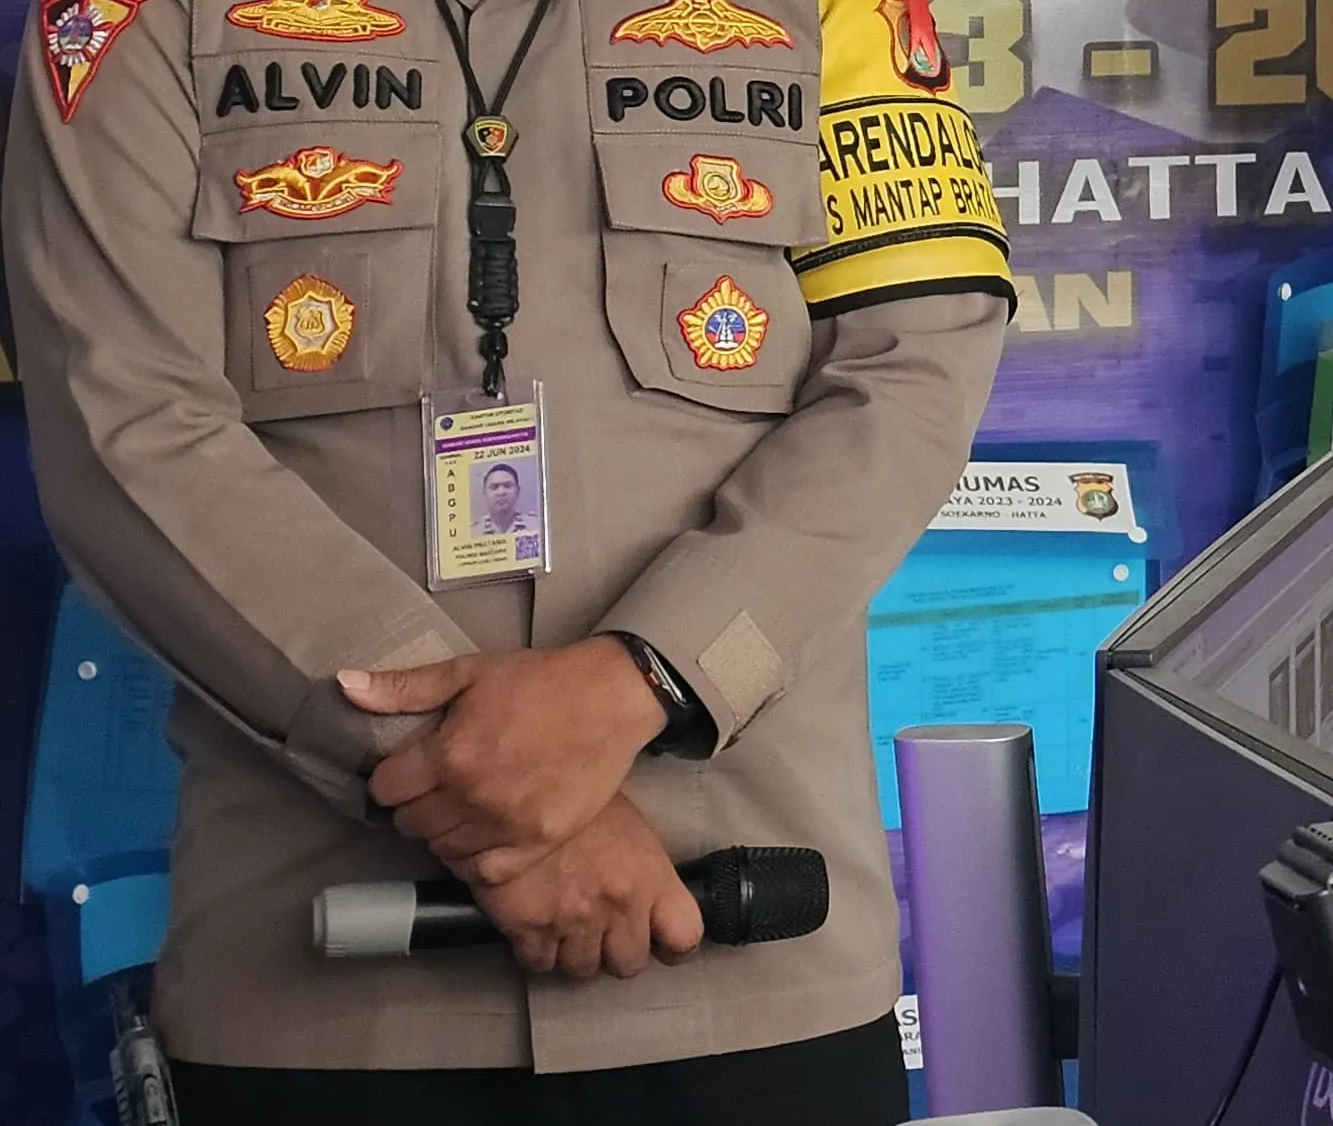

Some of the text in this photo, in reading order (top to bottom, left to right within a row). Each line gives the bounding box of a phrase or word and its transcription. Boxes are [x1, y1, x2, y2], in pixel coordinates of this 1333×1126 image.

[216, 62, 423, 118] ALVIN
[606, 76, 802, 131] POLRI
[850, 178, 943, 230] MANTAP
[948, 497, 973, 506] YA
[979, 497, 1013, 506] 2023
[1028, 497, 1063, 507] 2024
